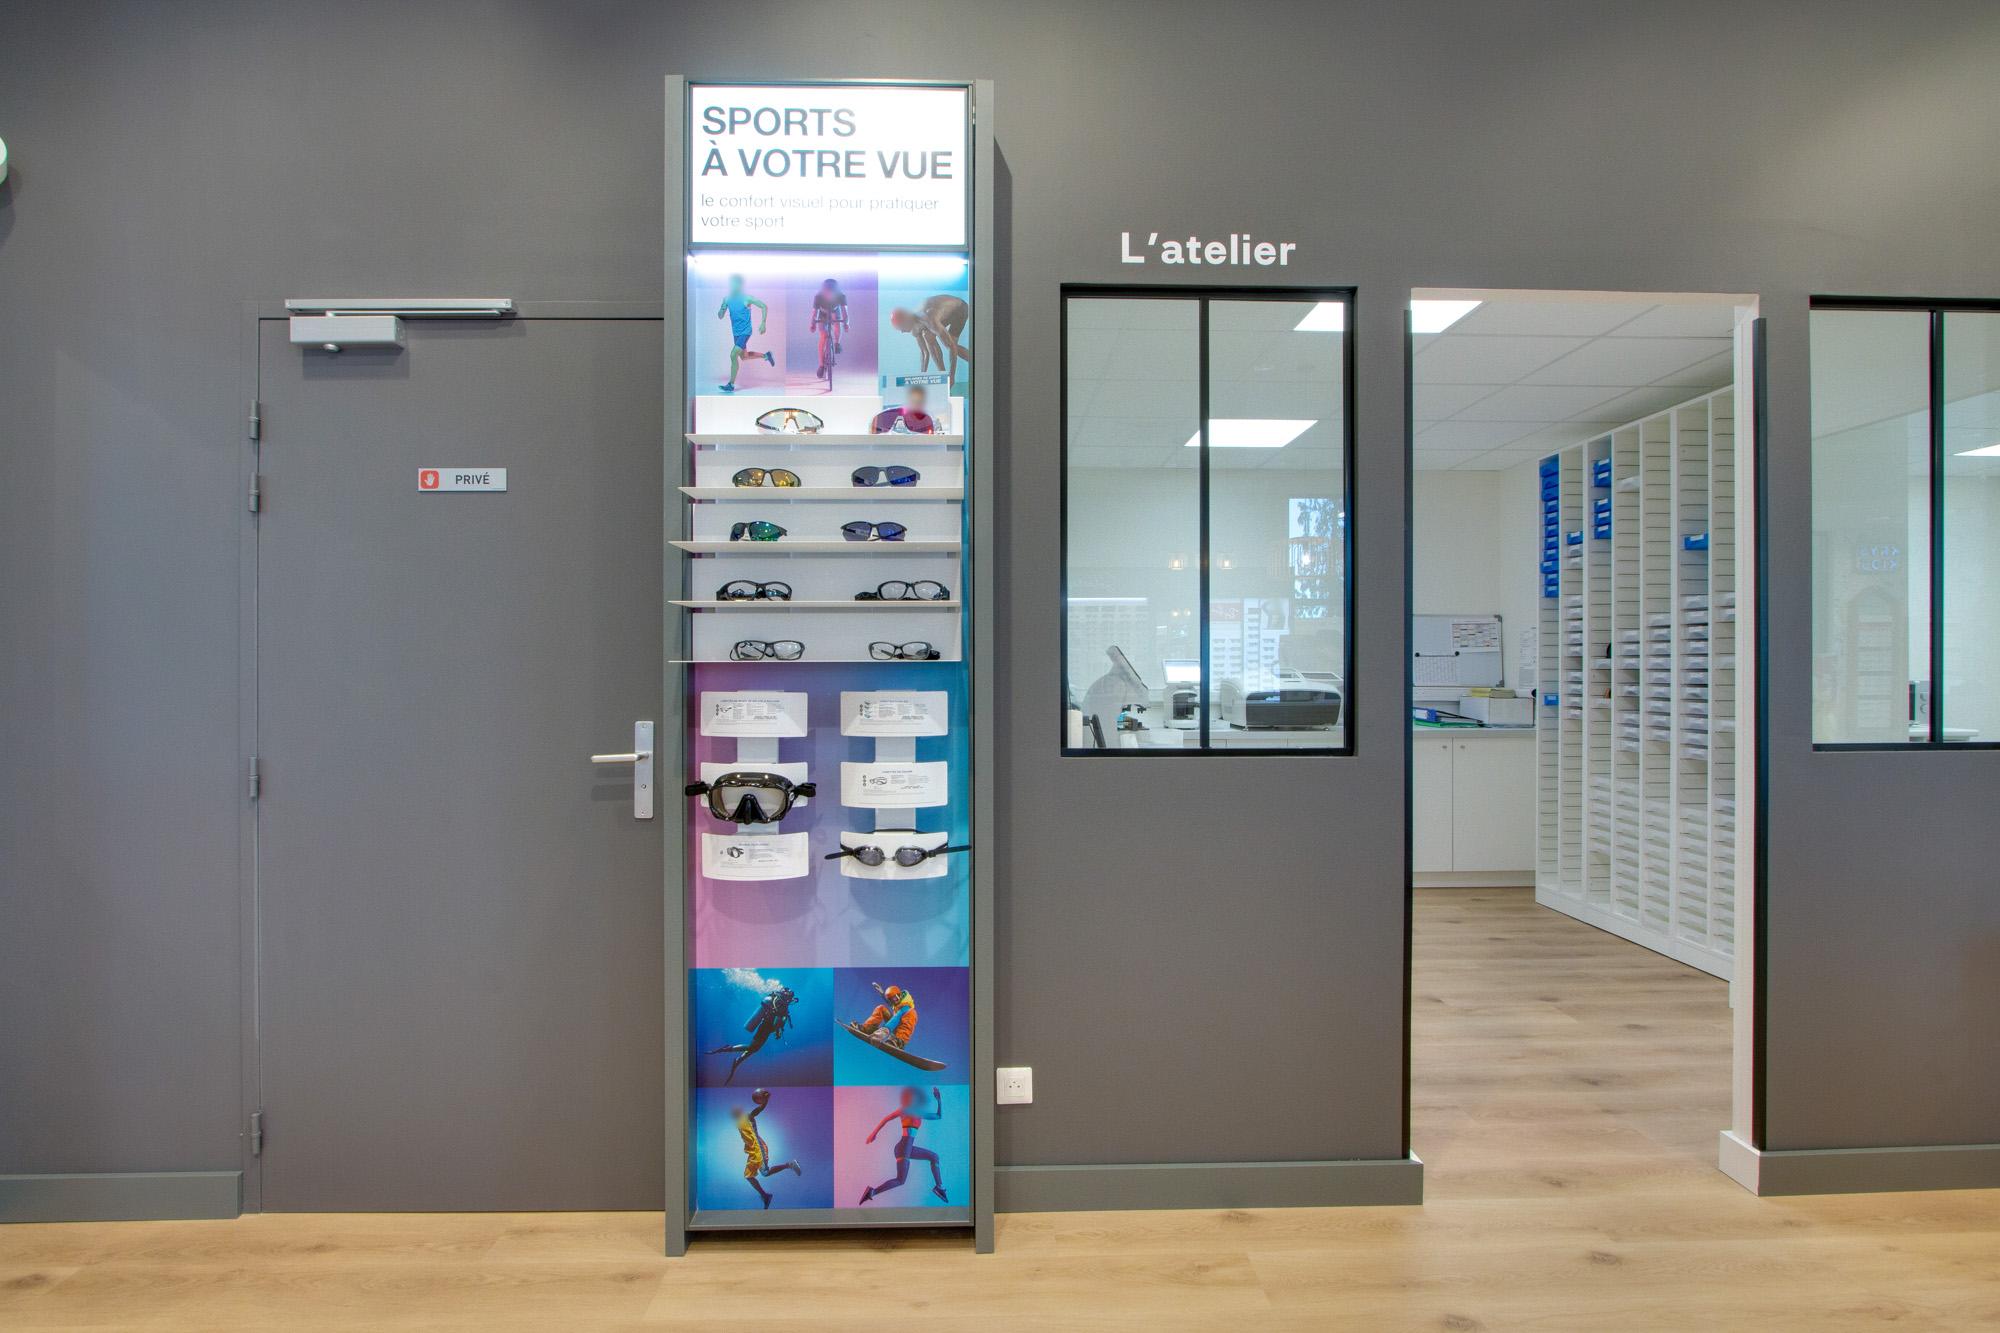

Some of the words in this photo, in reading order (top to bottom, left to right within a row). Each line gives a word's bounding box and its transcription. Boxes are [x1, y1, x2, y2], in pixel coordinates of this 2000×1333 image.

[702, 106, 856, 137] SPORTS
[701, 139, 728, 177] À
[737, 148, 867, 179] VOTRE
[876, 150, 953, 180] VUE
[701, 193, 715, 208] le
[719, 193, 775, 209] confort
[779, 194, 824, 210] visuel
[829, 197, 865, 213] pour
[869, 195, 940, 213] pratiquer
[701, 214, 740, 228] votre
[744, 214, 785, 230] sport
[1121, 231, 1297, 266] L'atelier
[455, 471, 491, 485] PRIVÉ
